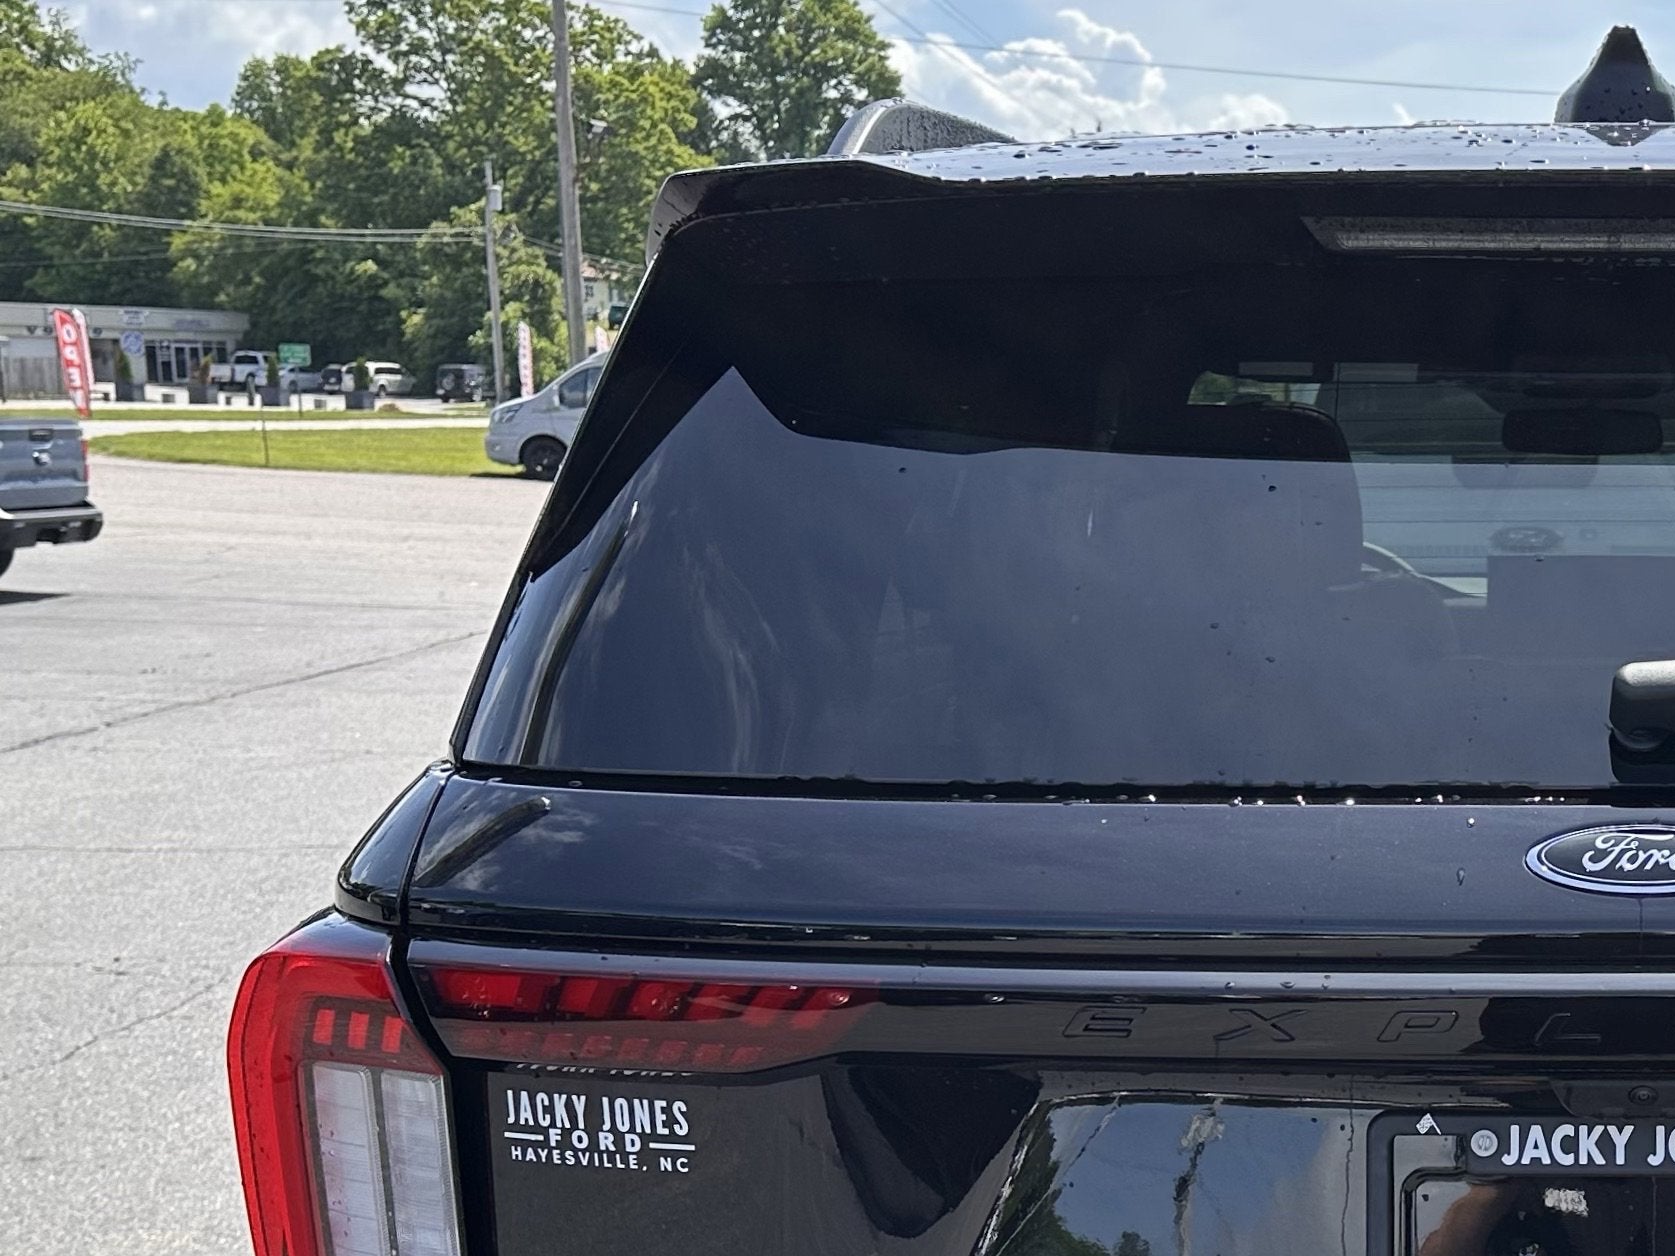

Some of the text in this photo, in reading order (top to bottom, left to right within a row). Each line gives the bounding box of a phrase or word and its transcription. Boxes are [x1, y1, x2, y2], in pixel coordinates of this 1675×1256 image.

[506, 1089, 689, 1136] JACKY JONES
[549, 1128, 642, 1153] FORD
[1501, 1123, 1635, 1167] JACKY
[511, 1146, 690, 1173] HAYESVILLE, NC
